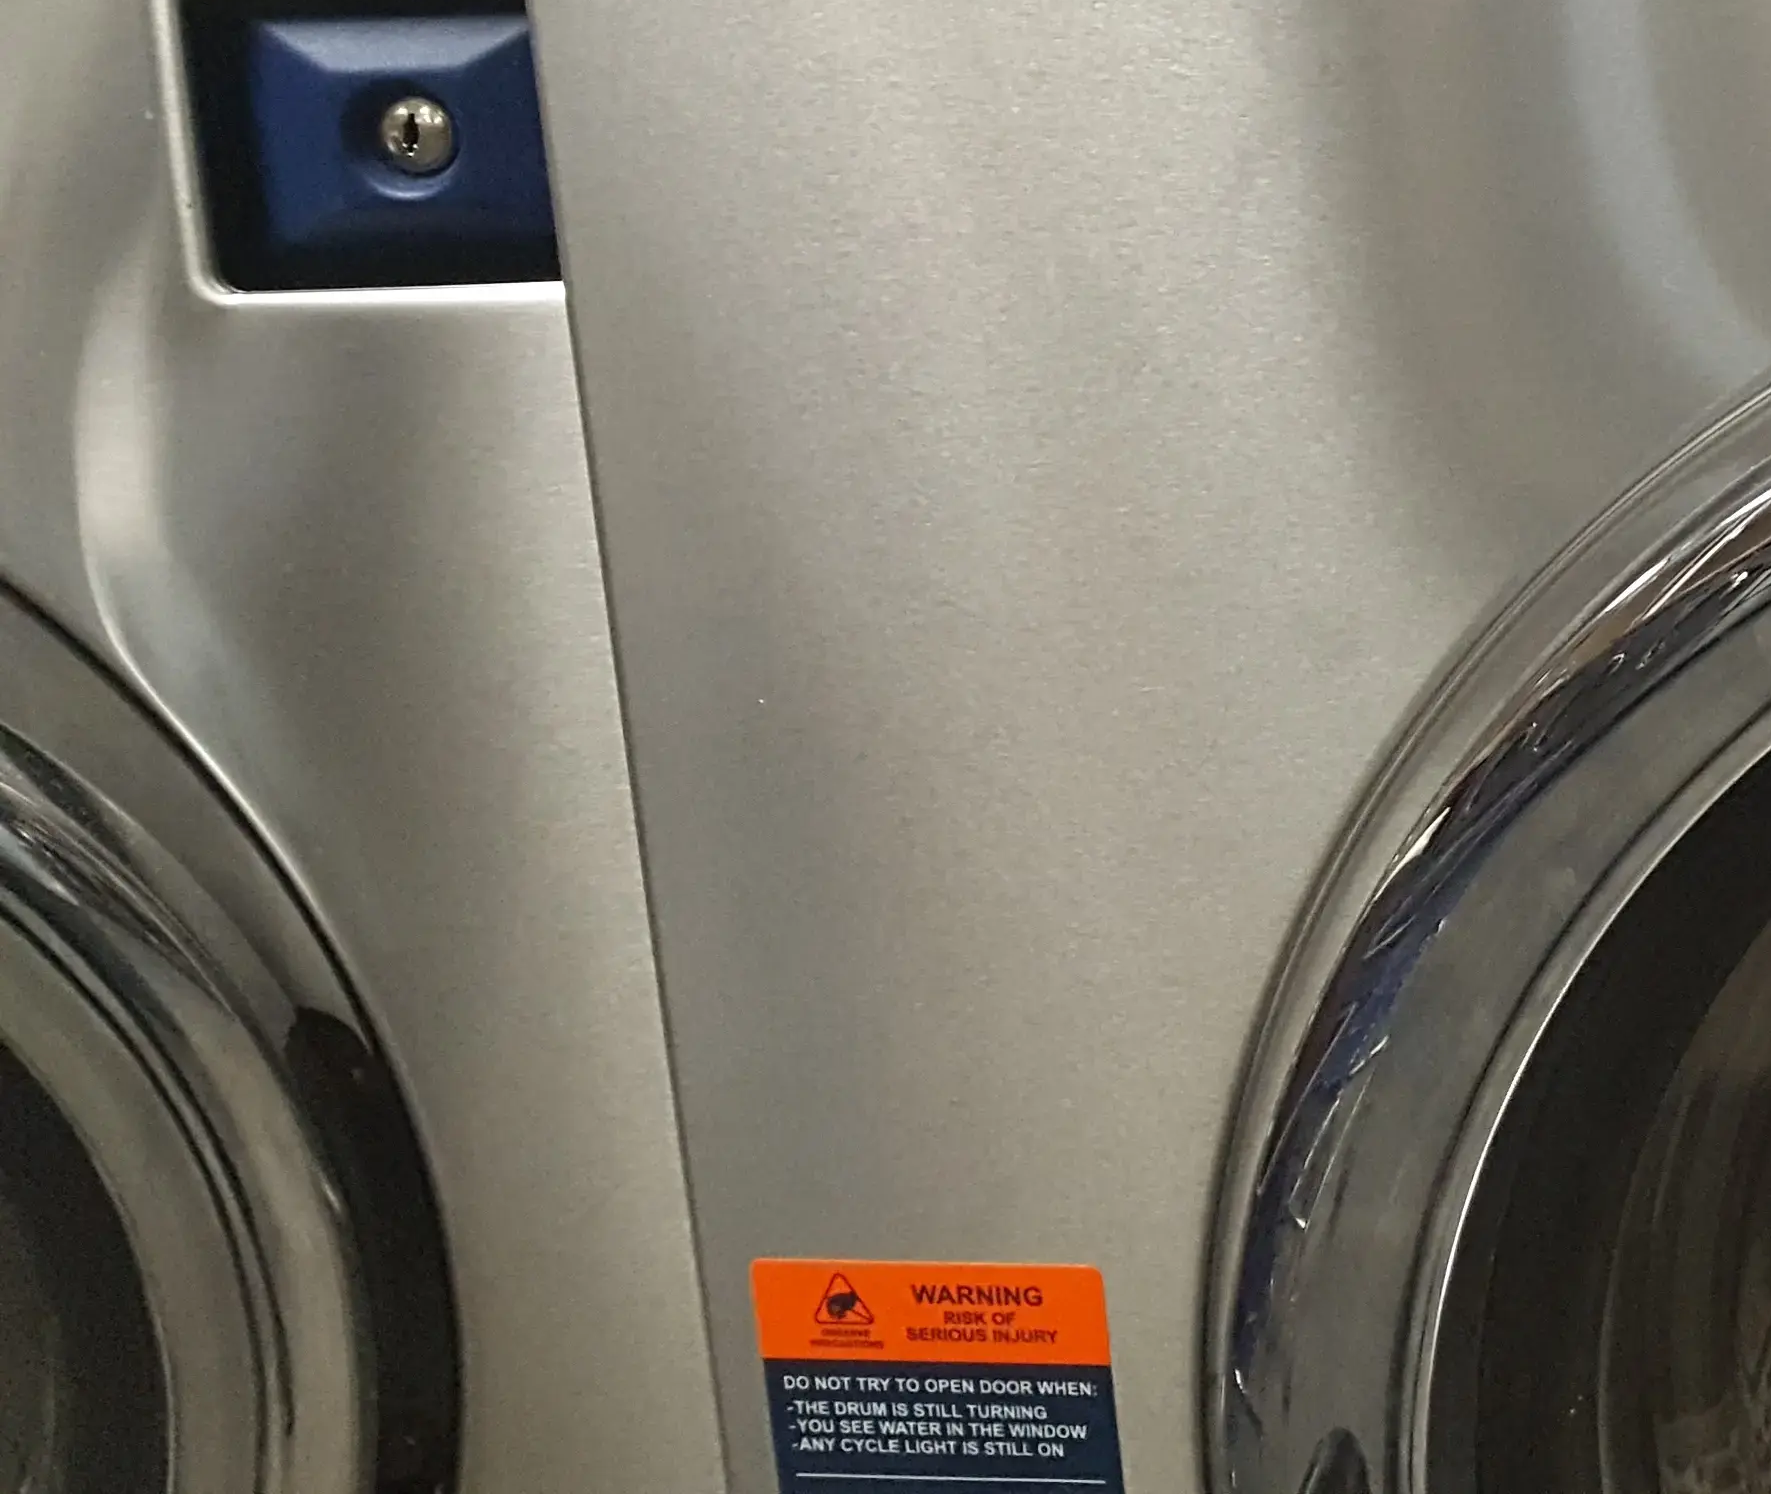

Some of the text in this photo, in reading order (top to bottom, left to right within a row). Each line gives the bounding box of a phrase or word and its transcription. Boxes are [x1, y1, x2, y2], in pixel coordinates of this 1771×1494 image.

[911, 1285, 1043, 1306] WARNING
[944, 1311, 1015, 1326] RISK OF
[907, 1327, 1057, 1344] SERIOUS INJURY
[784, 1376, 1097, 1396] DO NOT TRY TO OPEN DOOR WHEN:
[834, 1402, 887, 1416] DRUM
[892, 1403, 908, 1416] IS
[913, 1403, 963, 1418] STILL
[966, 1404, 1047, 1419] TURNING
